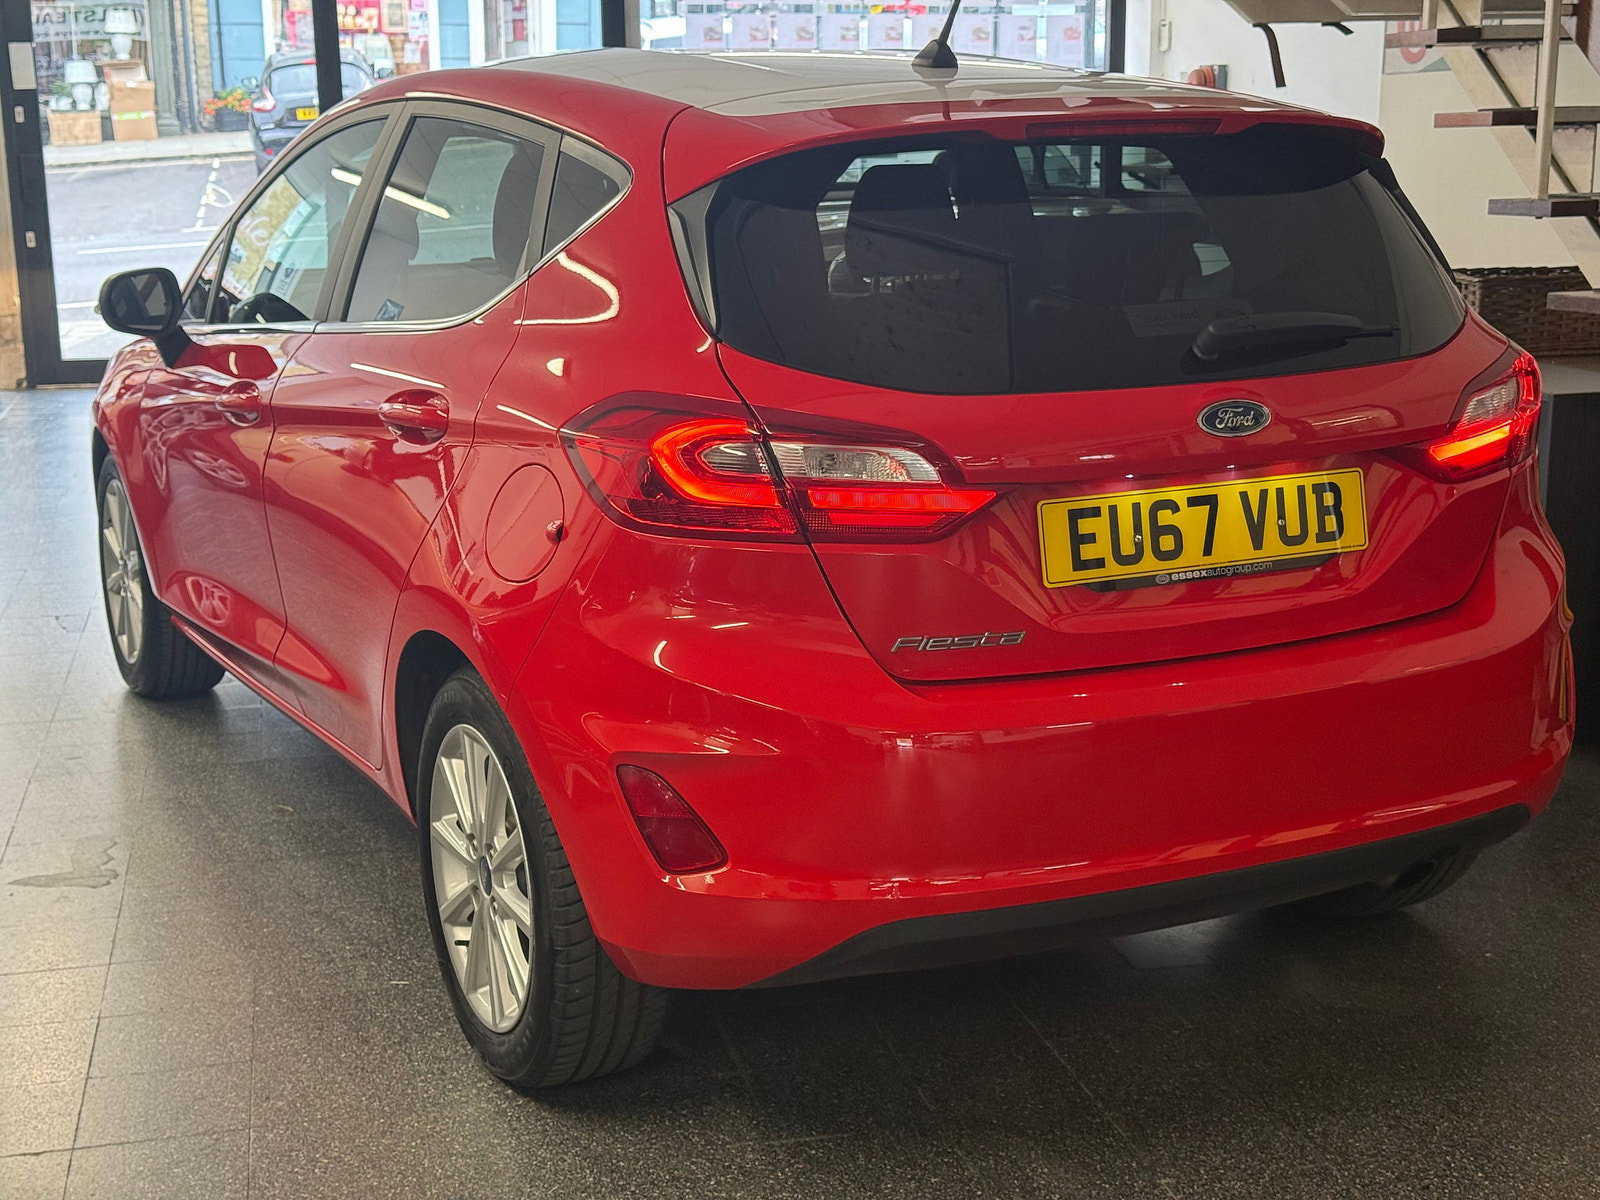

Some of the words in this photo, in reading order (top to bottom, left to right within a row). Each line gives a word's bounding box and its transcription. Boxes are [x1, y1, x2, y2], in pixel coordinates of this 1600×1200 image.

[1215, 407, 1255, 429] Ford
[1067, 494, 1219, 572] EU67
[1239, 481, 1345, 551] VUB
[1171, 561, 1273, 581] essexautogroup.com
[890, 630, 1026, 653] Fiesta
